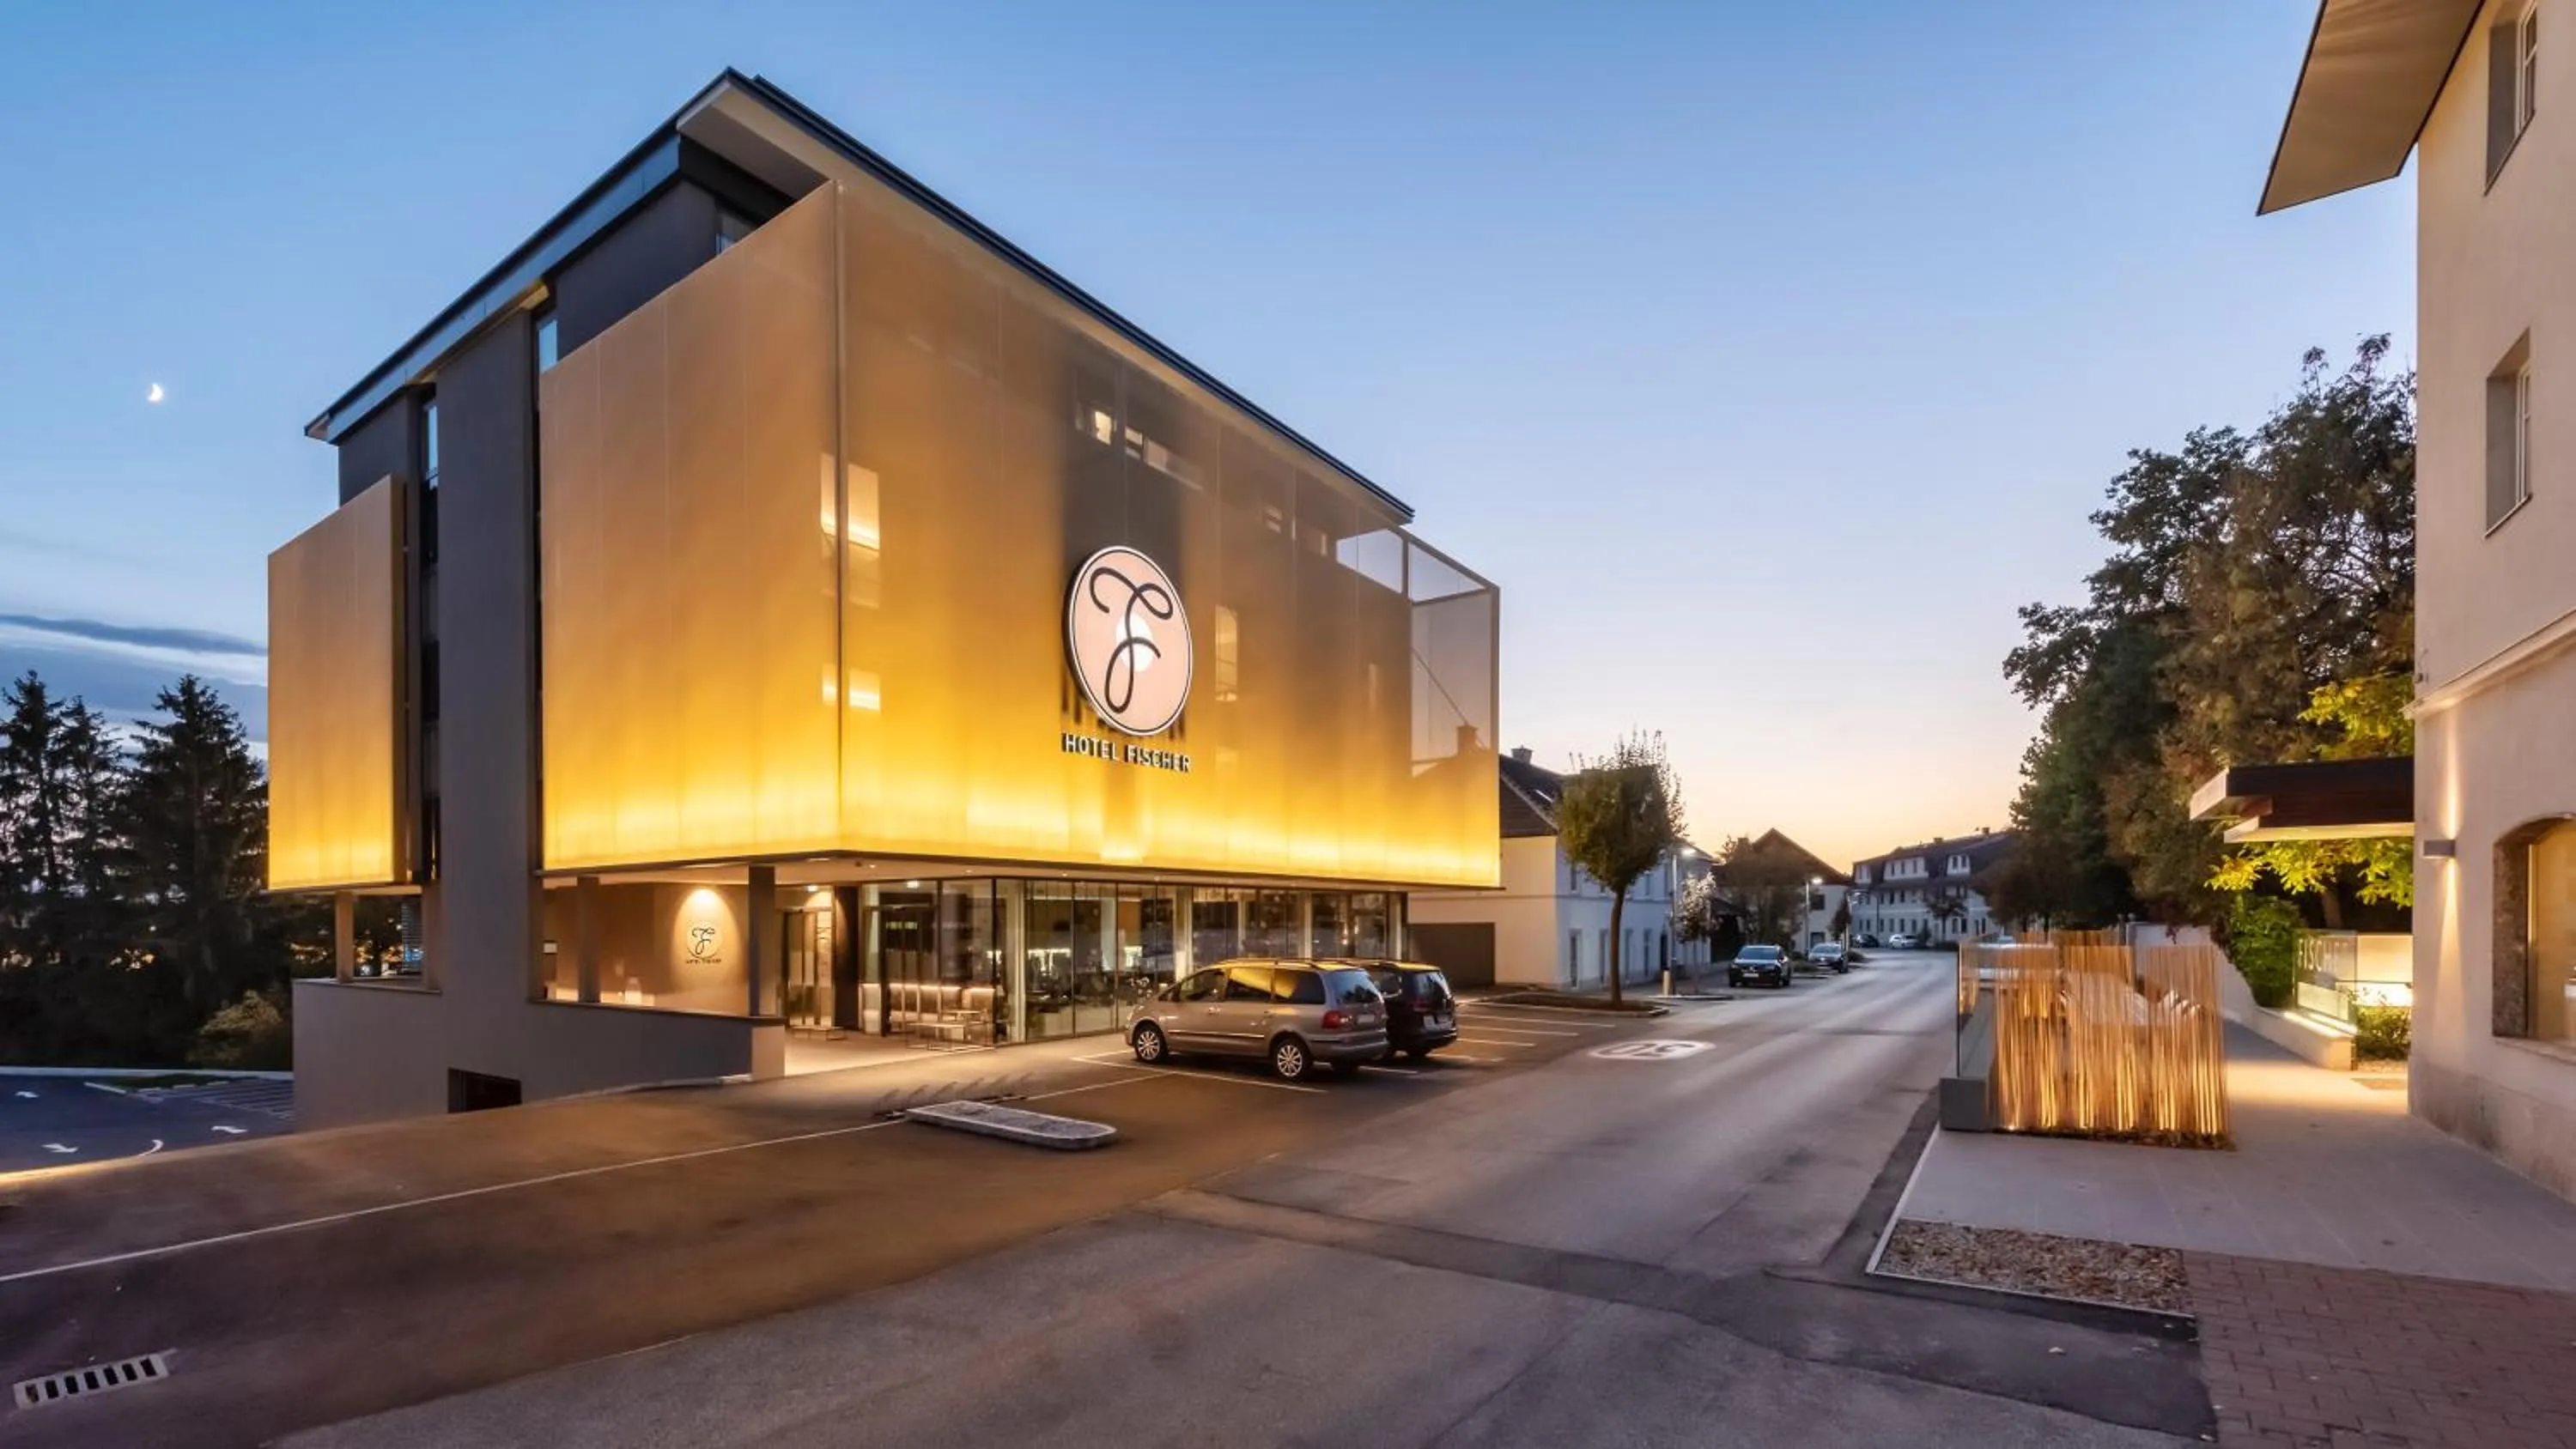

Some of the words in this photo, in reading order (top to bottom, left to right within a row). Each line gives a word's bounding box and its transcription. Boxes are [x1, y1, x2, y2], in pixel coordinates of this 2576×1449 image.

[1062, 732, 1120, 761] HOTEL
[1124, 743, 1191, 773] FISCHER
[2298, 938, 2350, 973] FISCHE
